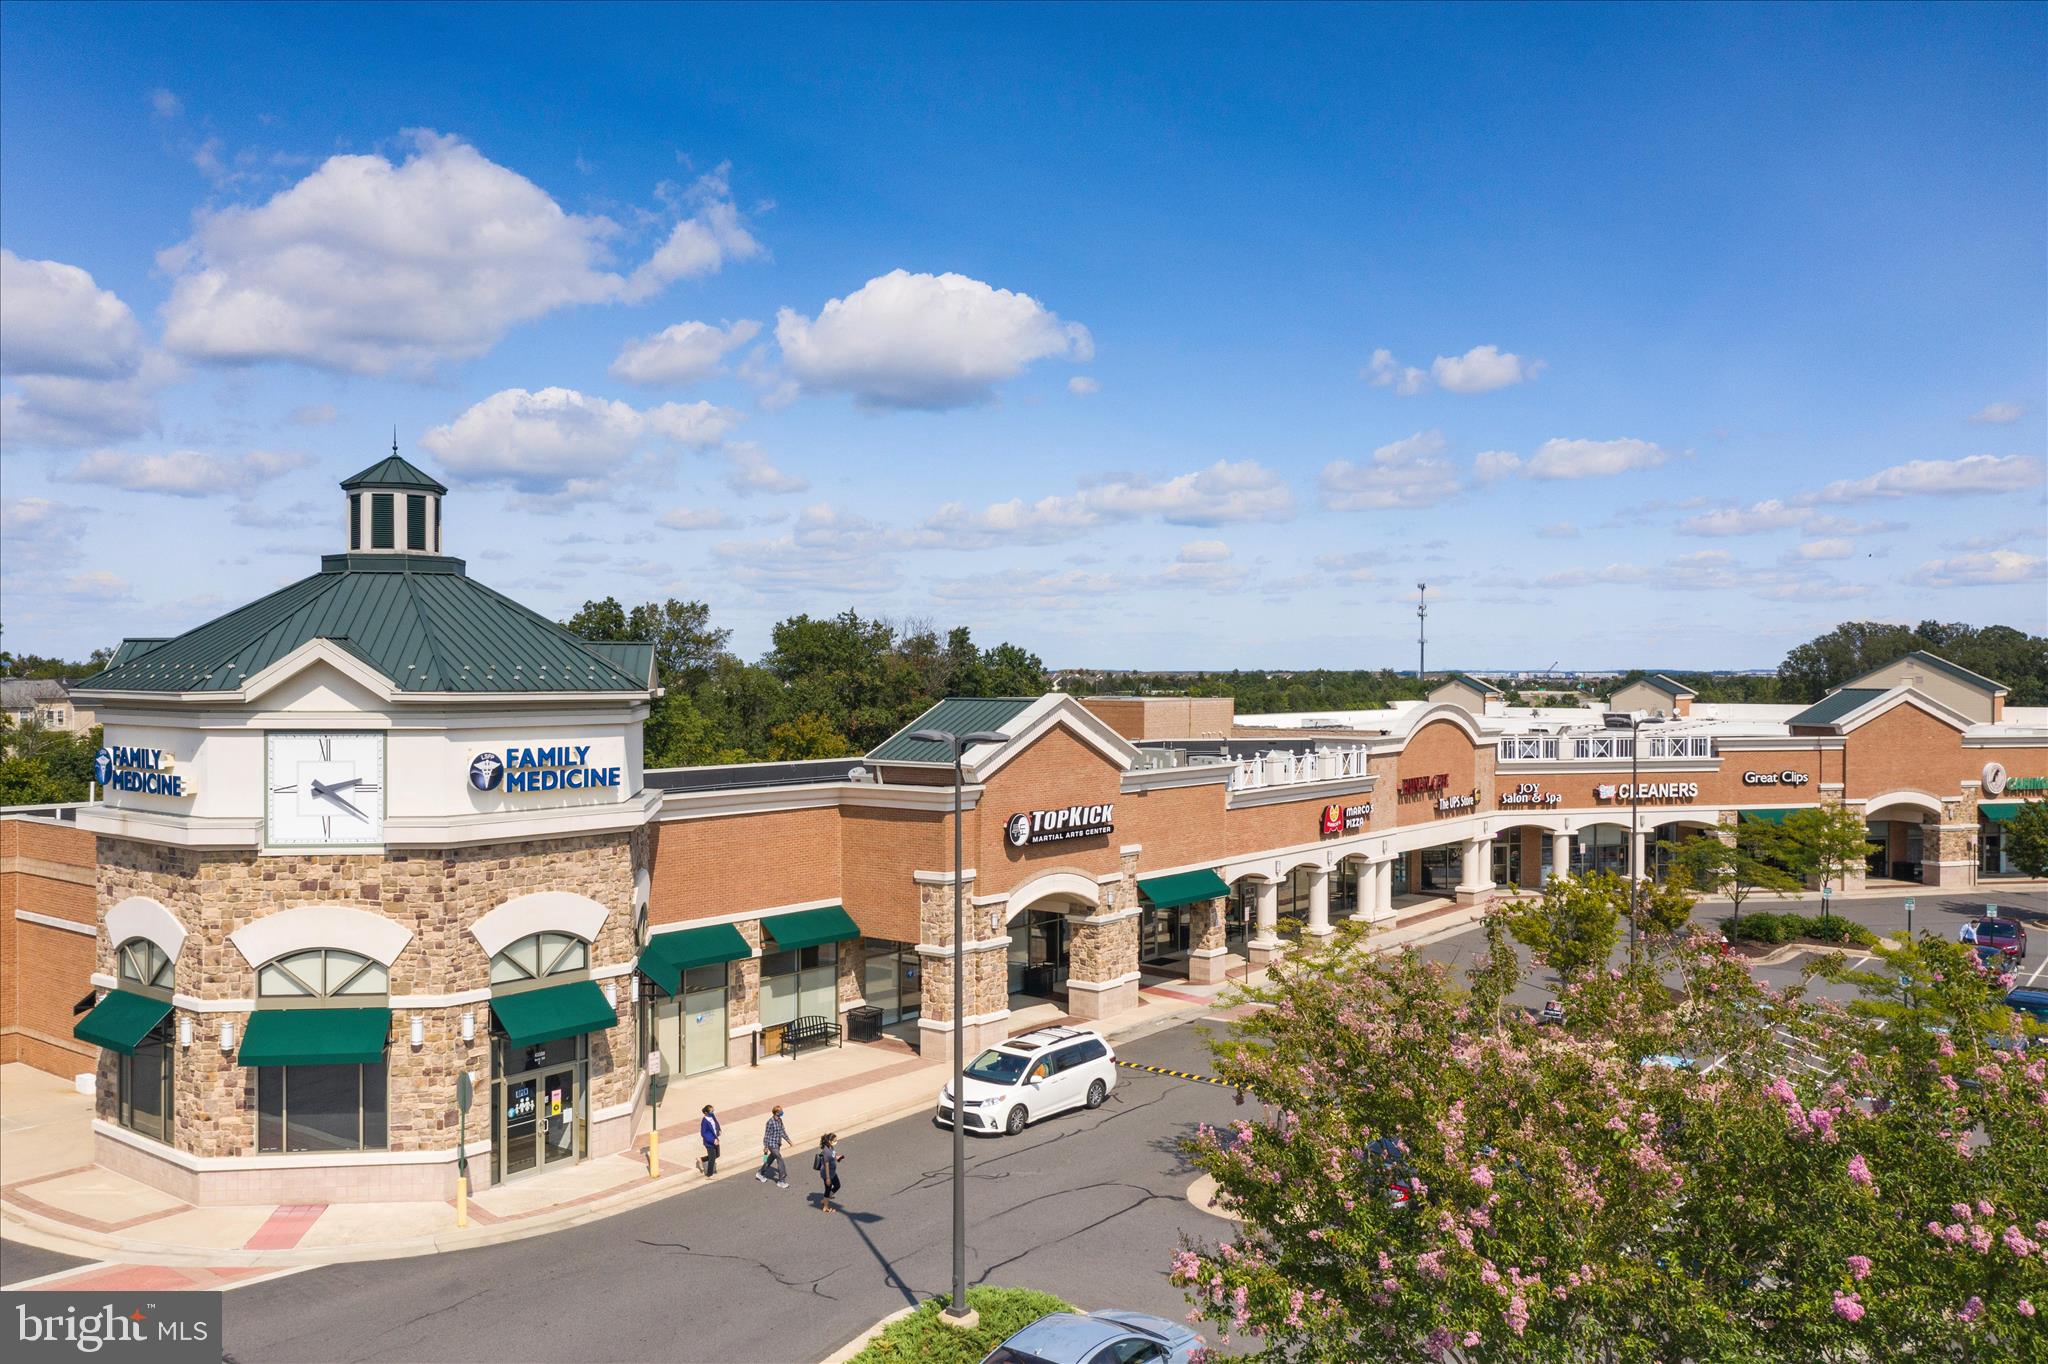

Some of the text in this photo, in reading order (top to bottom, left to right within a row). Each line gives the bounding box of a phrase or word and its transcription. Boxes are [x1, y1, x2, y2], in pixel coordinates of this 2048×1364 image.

[112, 746, 162, 770] FAMILY
[506, 746, 591, 768] FAMILY
[112, 769, 182, 797] MEDICINE
[506, 767, 621, 793] MEDICINE
[1744, 771, 1809, 785] Great Clips
[1519, 783, 1540, 795] JOY
[1619, 783, 1698, 799] CLEANERS
[1440, 795, 1474, 810] The UPS Store
[1502, 792, 1562, 804] Salon & Spa
[1032, 804, 1114, 832] TOPKICK
[1346, 817, 1364, 829] PIZZA
[1032, 826, 1111, 843] MARTIAL ARTS CENTER
